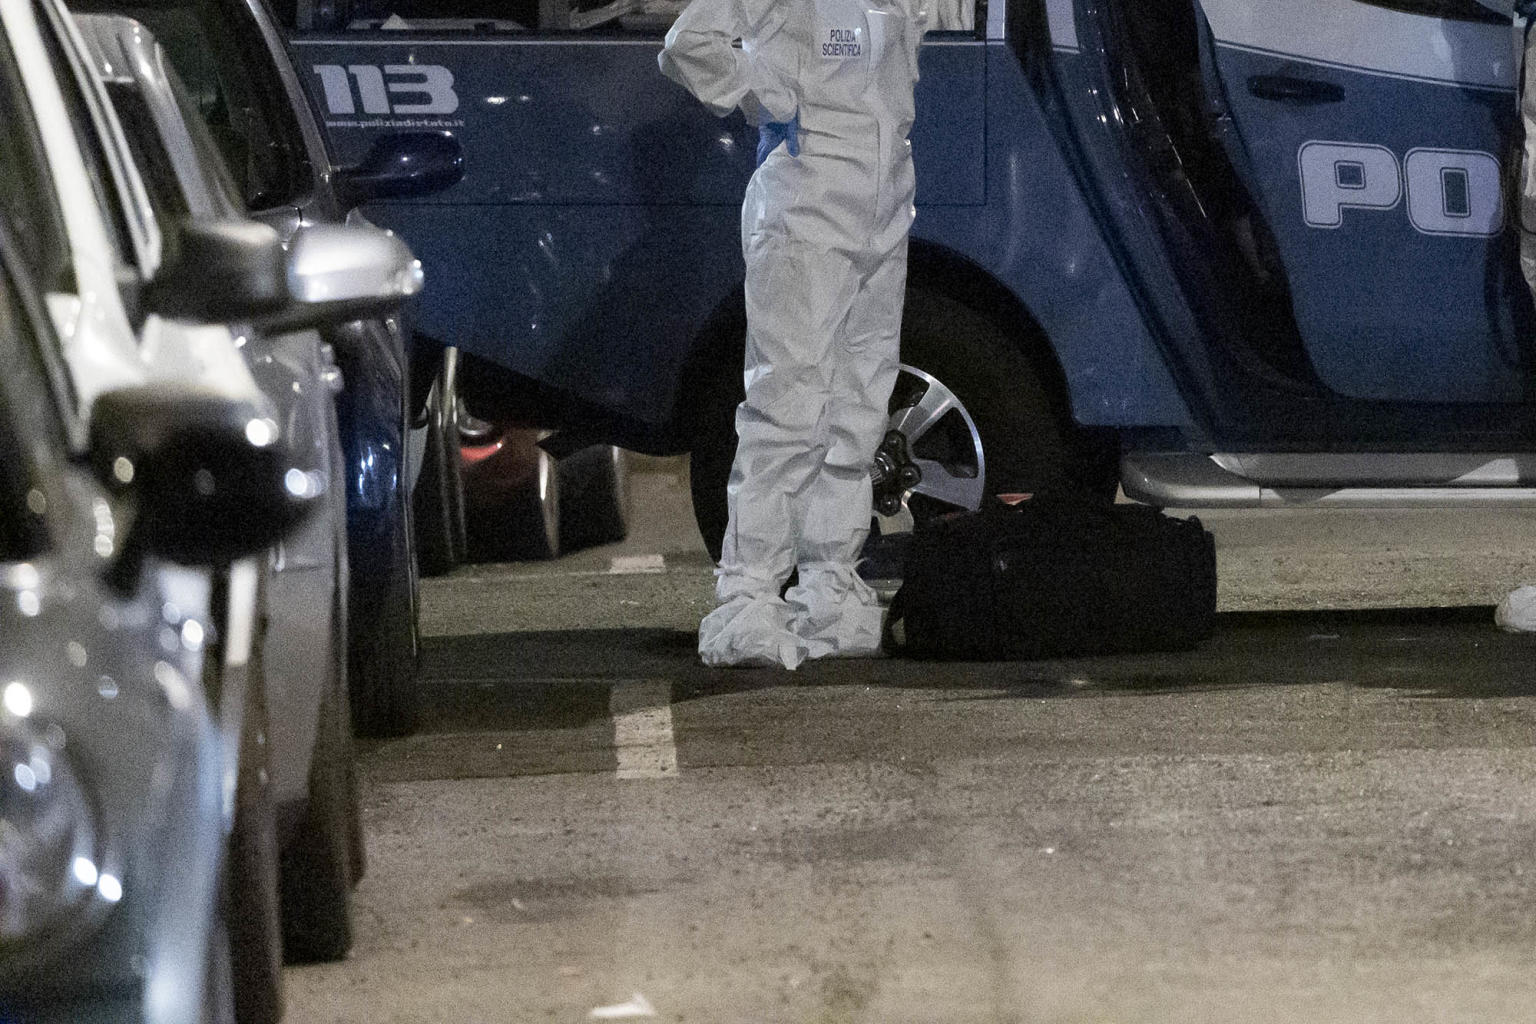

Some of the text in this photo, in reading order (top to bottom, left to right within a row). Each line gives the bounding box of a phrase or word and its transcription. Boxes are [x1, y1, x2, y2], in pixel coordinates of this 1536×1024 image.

[822, 42, 861, 56] SCIENTIFICA
[312, 64, 459, 114] 113
[1297, 139, 1503, 238] PO
